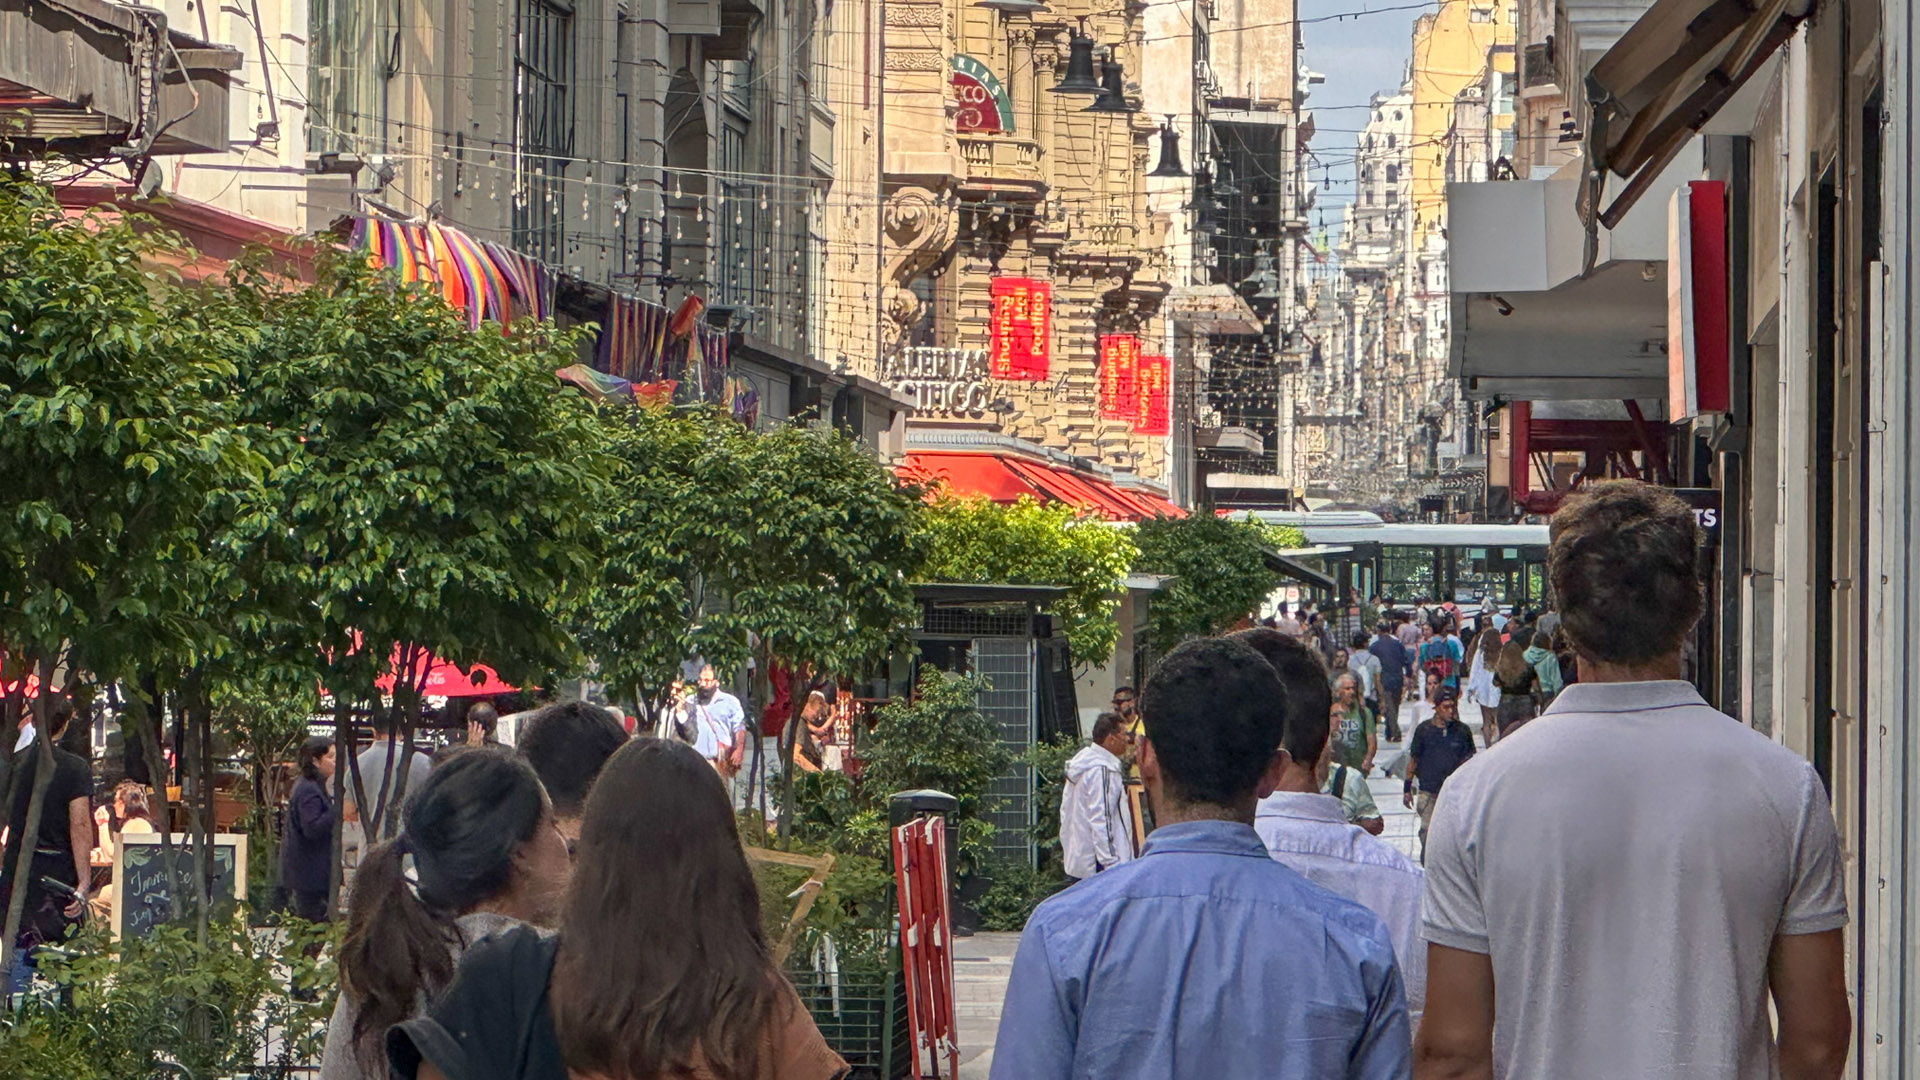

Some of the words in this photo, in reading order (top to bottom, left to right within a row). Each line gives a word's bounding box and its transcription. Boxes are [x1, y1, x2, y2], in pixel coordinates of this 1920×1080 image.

[957, 57, 1001, 96] RIAS
[1013, 287, 1028, 320] Mall
[996, 295, 1015, 372] Shopping
[1119, 340, 1130, 370] Mall
